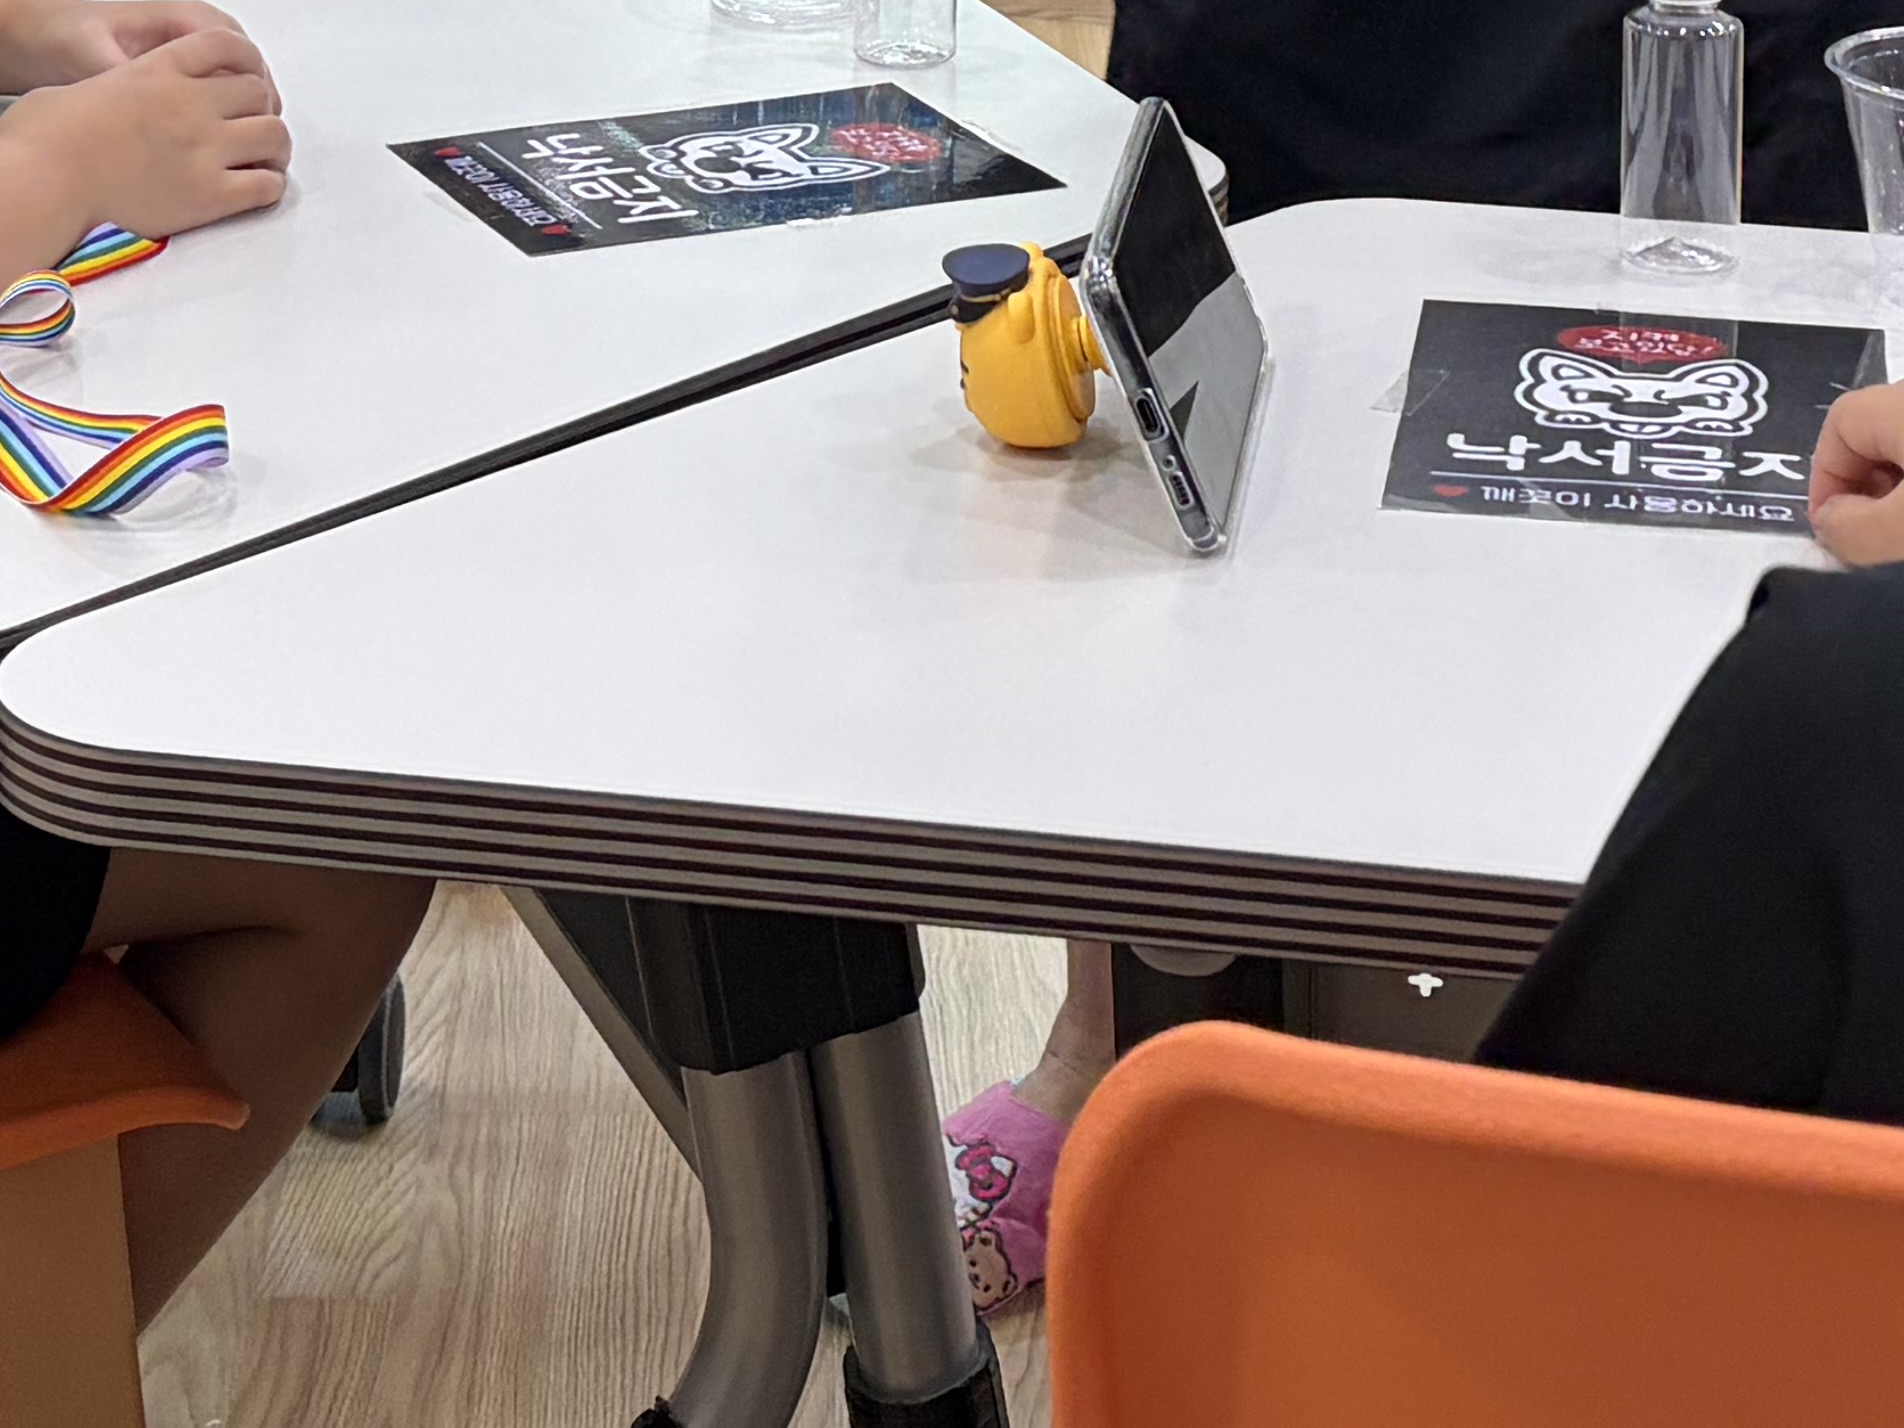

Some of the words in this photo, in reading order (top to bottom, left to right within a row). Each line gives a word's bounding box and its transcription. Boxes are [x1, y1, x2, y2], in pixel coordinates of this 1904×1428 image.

[522, 134, 699, 224] 낙서금지
[475, 180, 558, 227] 사용하세요
[1481, 486, 1590, 508] 깨끗이
[1604, 493, 1795, 522] 사용하세요
